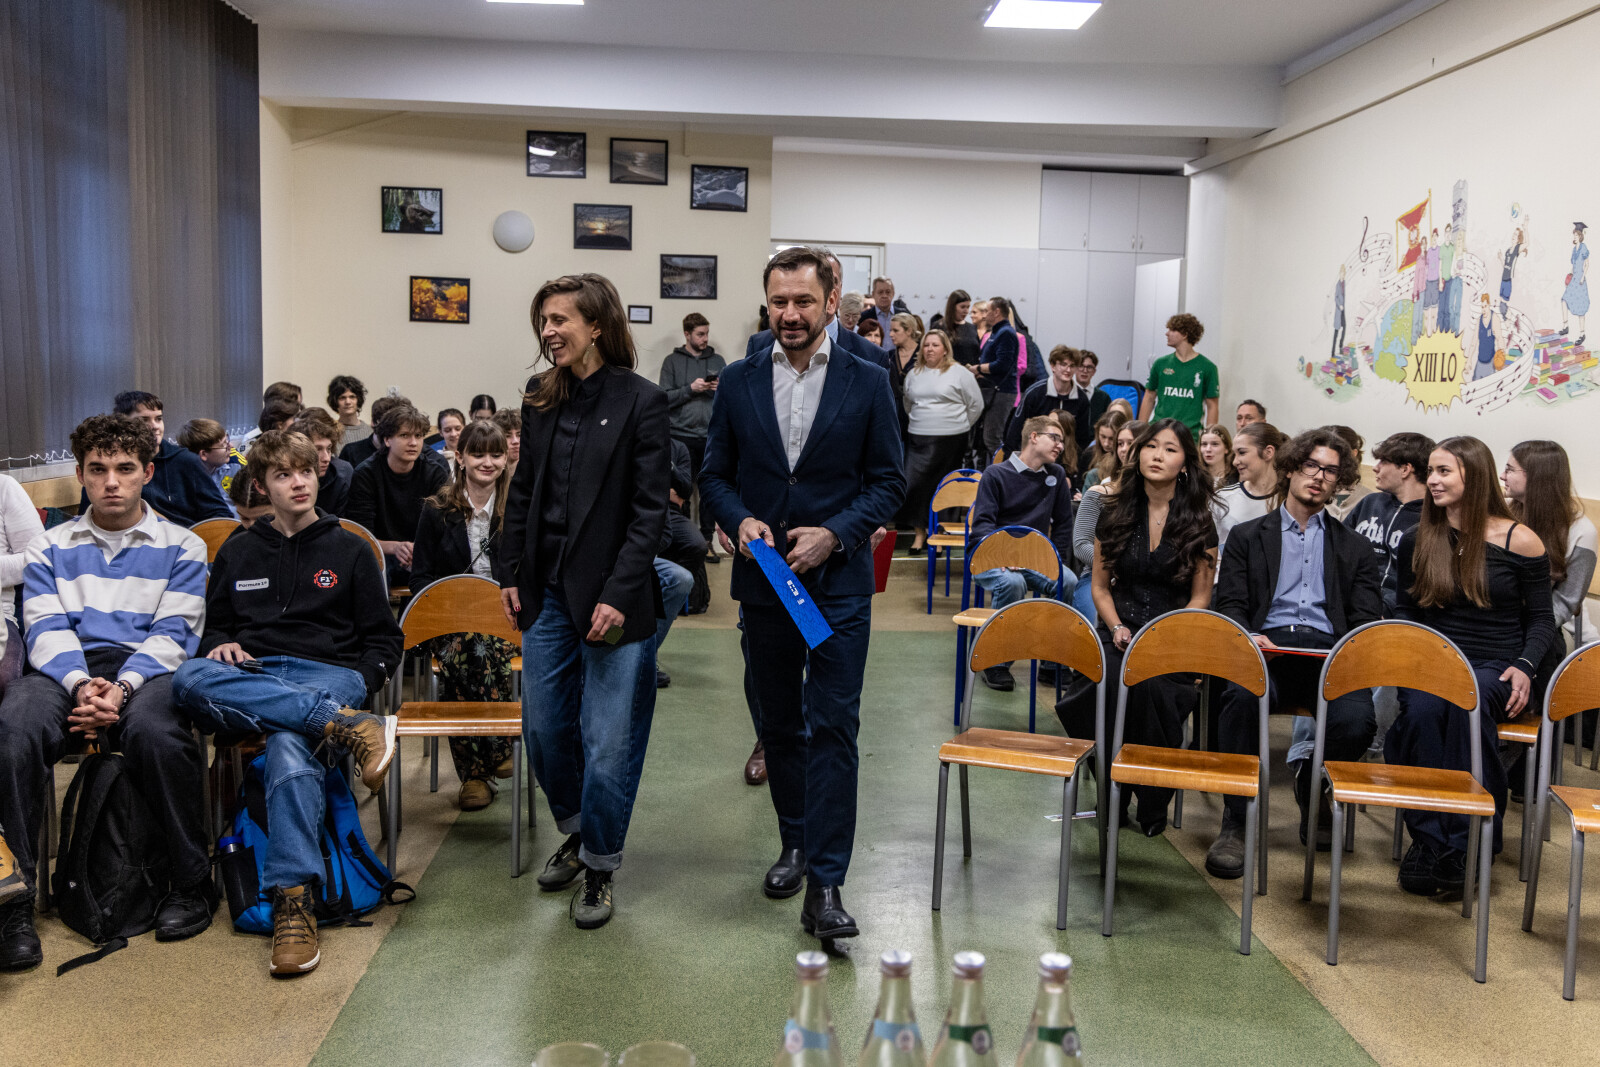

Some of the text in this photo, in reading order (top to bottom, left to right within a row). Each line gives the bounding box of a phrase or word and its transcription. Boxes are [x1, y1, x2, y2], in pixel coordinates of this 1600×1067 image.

[1413, 352, 1457, 382] XIII LO
[1163, 386, 1194, 399] ITALIA
